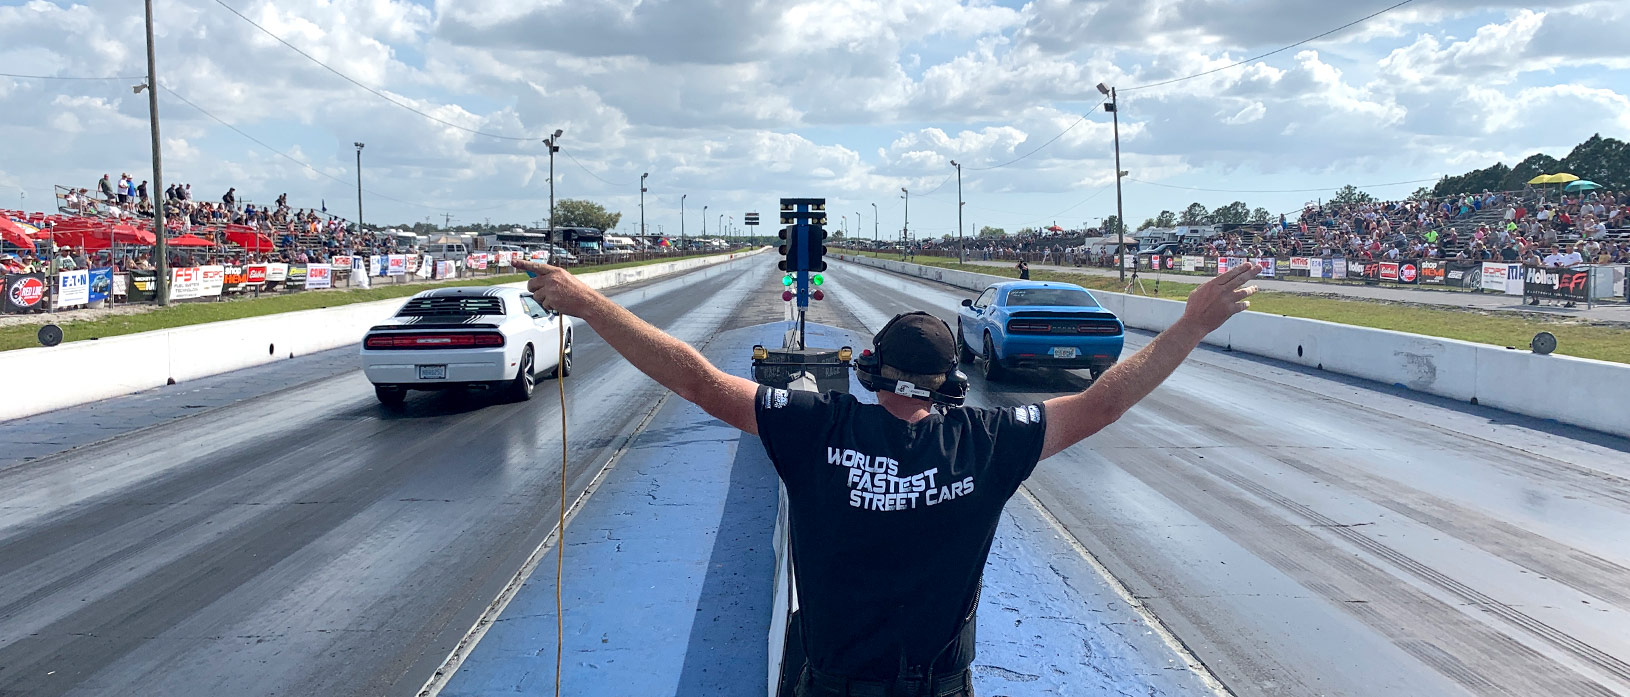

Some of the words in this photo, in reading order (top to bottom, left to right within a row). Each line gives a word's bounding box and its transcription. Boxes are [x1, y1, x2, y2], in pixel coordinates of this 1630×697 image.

[225, 266, 241, 275] shop
[1348, 261, 1364, 276] Holley
[1421, 268, 1445, 276] HEMI
[1422, 261, 1437, 269] shop
[174, 268, 200, 282] FST
[1526, 267, 1559, 290] Holley
[1558, 272, 1587, 293] EFI
[21, 287, 32, 297] RED
[827, 447, 899, 476] WORLD'S
[847, 467, 938, 493] FASTEST
[850, 490, 920, 511] STREET
[925, 476, 975, 506] CARS
